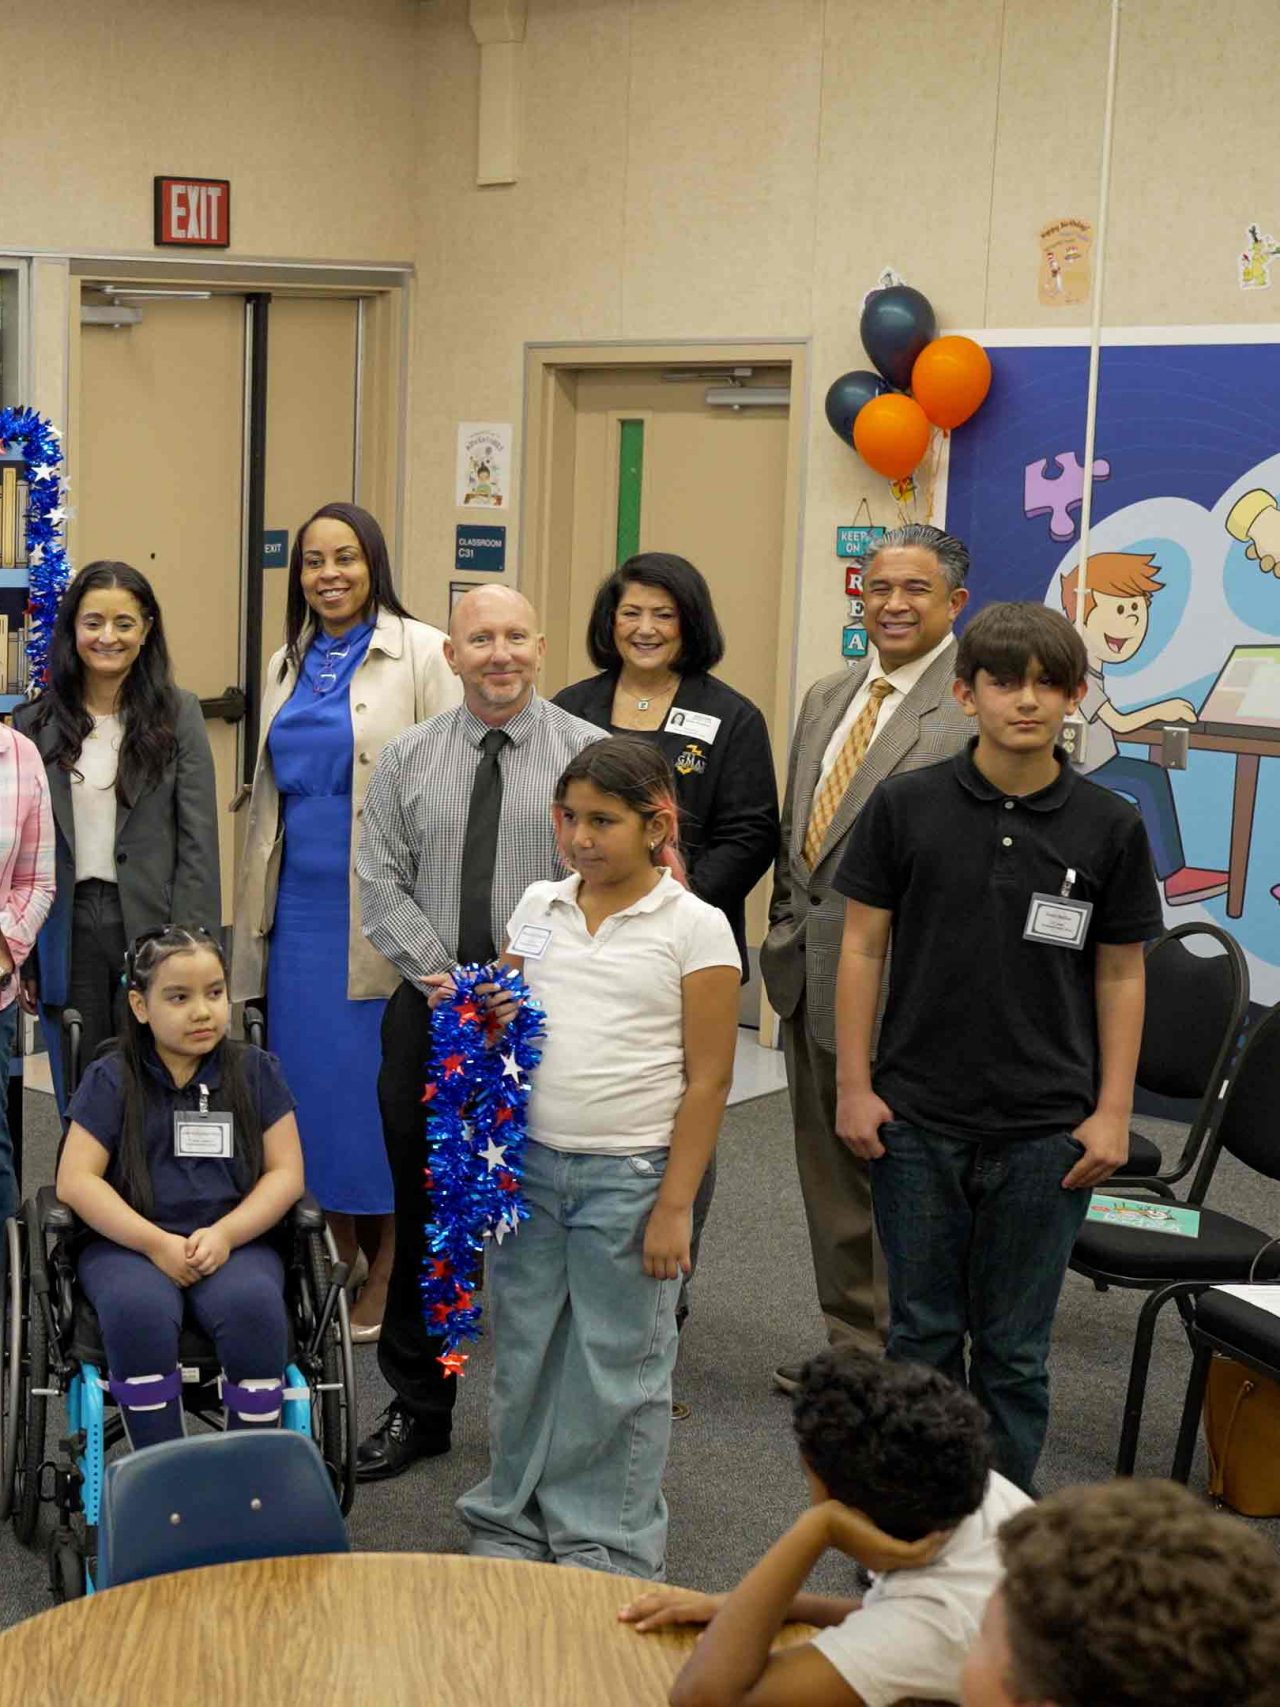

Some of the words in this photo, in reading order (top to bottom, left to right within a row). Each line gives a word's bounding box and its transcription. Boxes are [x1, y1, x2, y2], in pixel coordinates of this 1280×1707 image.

[171, 185, 222, 240] EXIT
[841, 530, 867, 543] KEEP
[264, 543, 282, 554] EXIT
[458, 537, 502, 549] CLASSROOM
[846, 543, 860, 553] ON
[458, 549, 474, 559] C31
